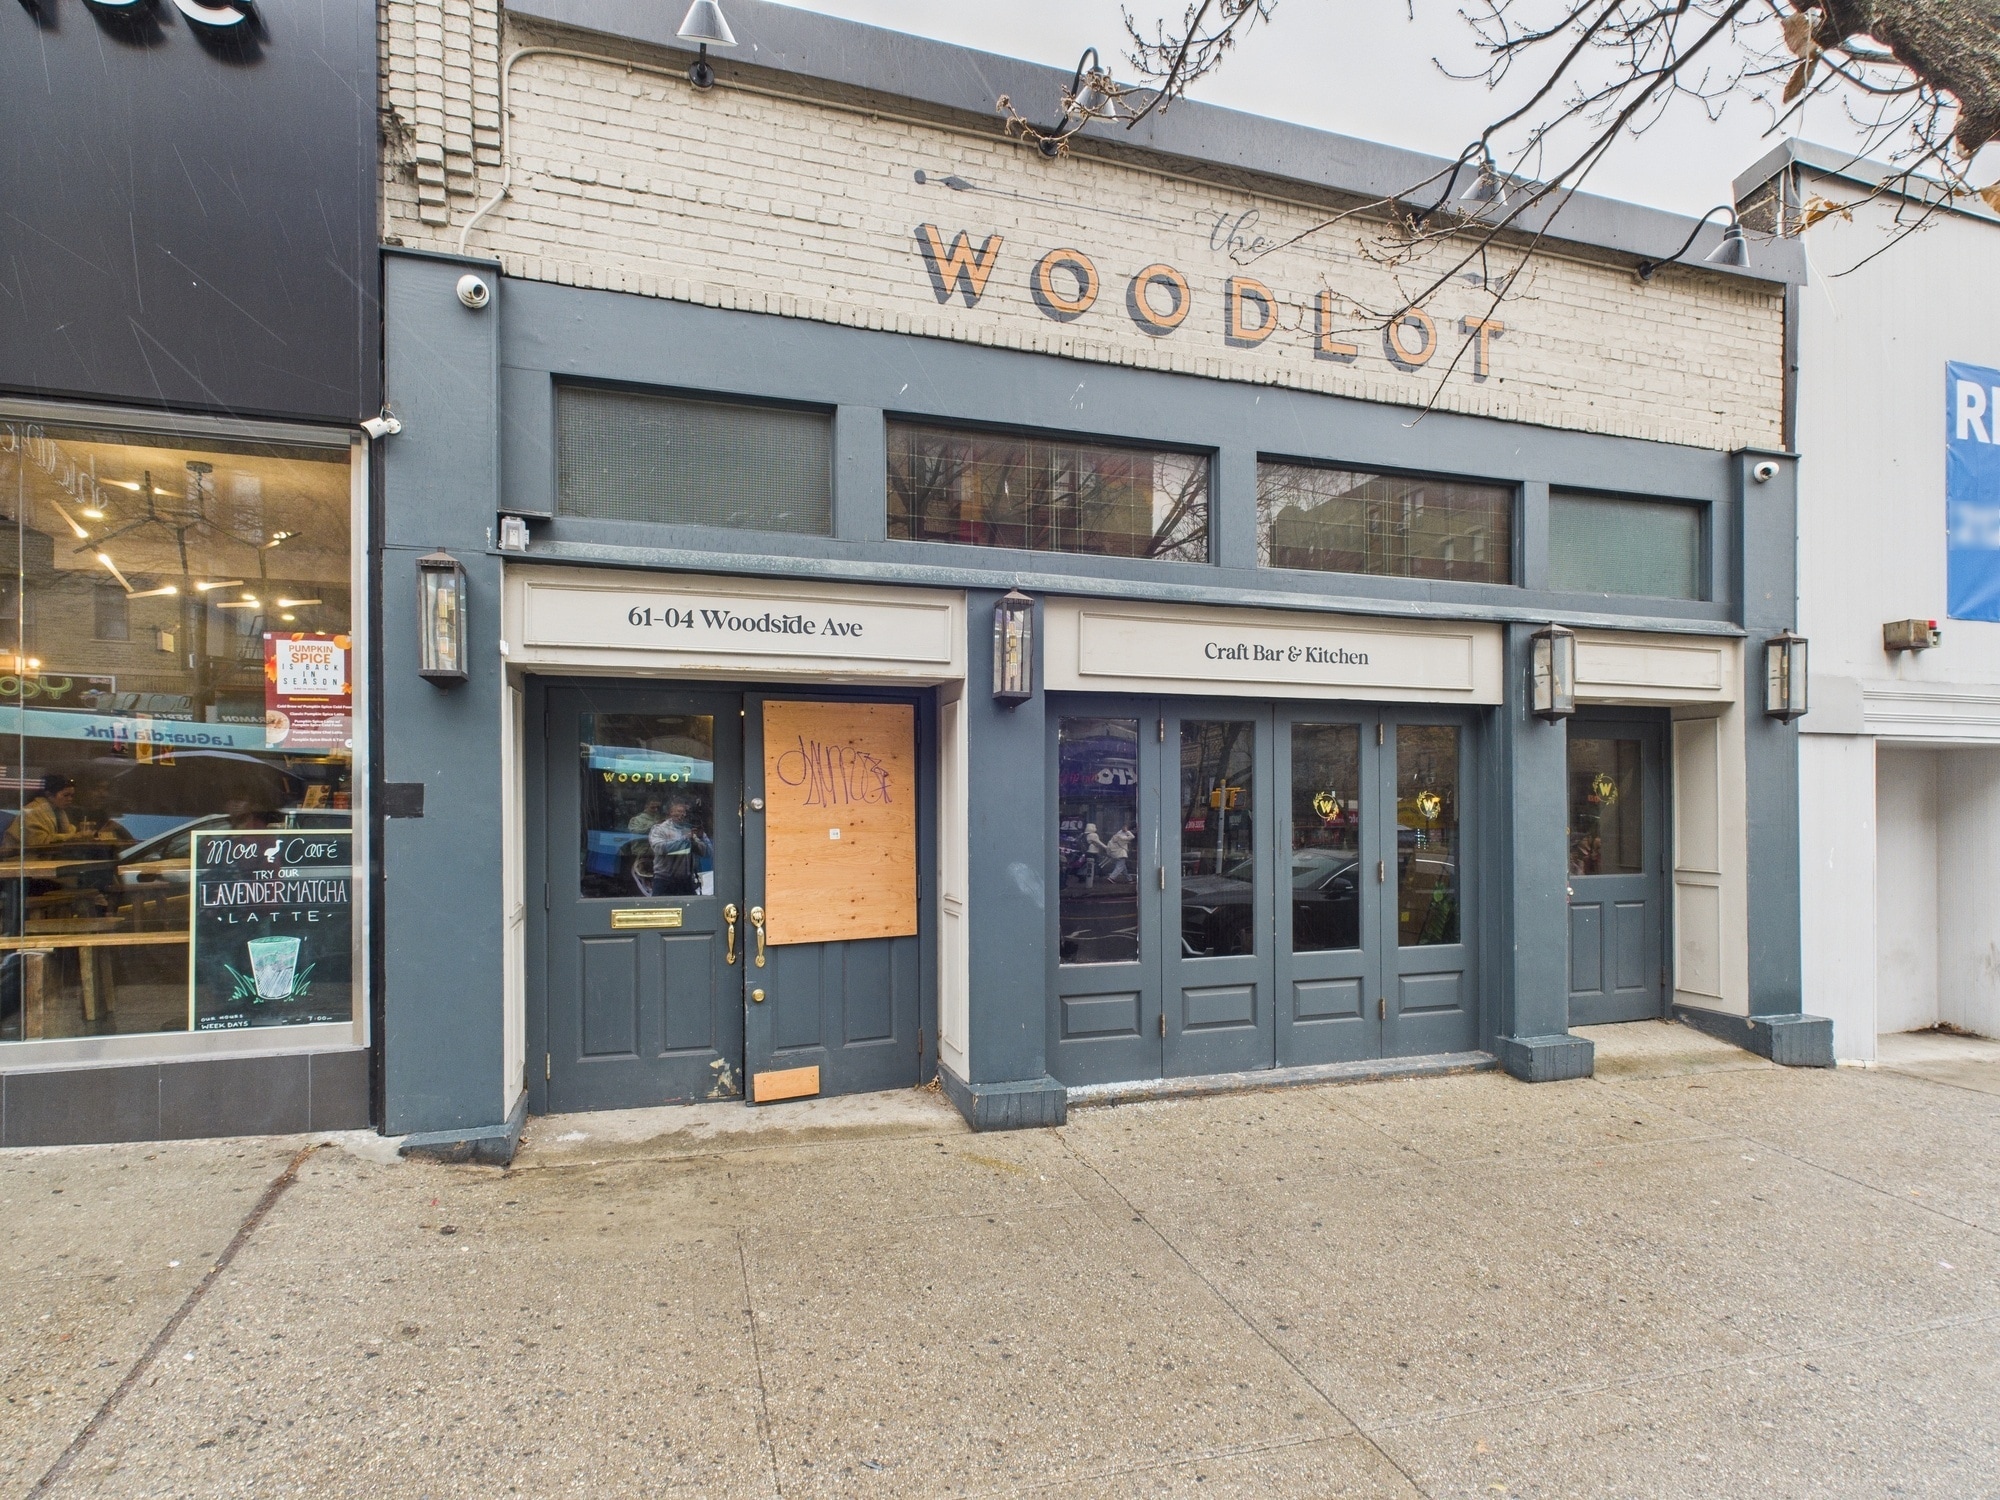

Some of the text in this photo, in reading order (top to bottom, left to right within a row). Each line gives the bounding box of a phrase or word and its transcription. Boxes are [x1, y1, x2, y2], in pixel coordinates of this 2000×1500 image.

[1208, 209, 1273, 254] the
[913, 221, 1505, 384] WOODLOT
[627, 606, 863, 638] 61-04 Woodside Ave
[288, 645, 333, 653] PUMPKIN
[1204, 642, 1369, 665] Craft Bar & Kitchen
[291, 653, 331, 664] SPICE
[305, 663, 339, 671] BACK
[283, 677, 338, 686] SEASON
[603, 772, 691, 783] WOODLOT
[206, 839, 258, 865] Moa
[252, 868, 300, 880] TRY OUR
[228, 911, 320, 924] LATTE
